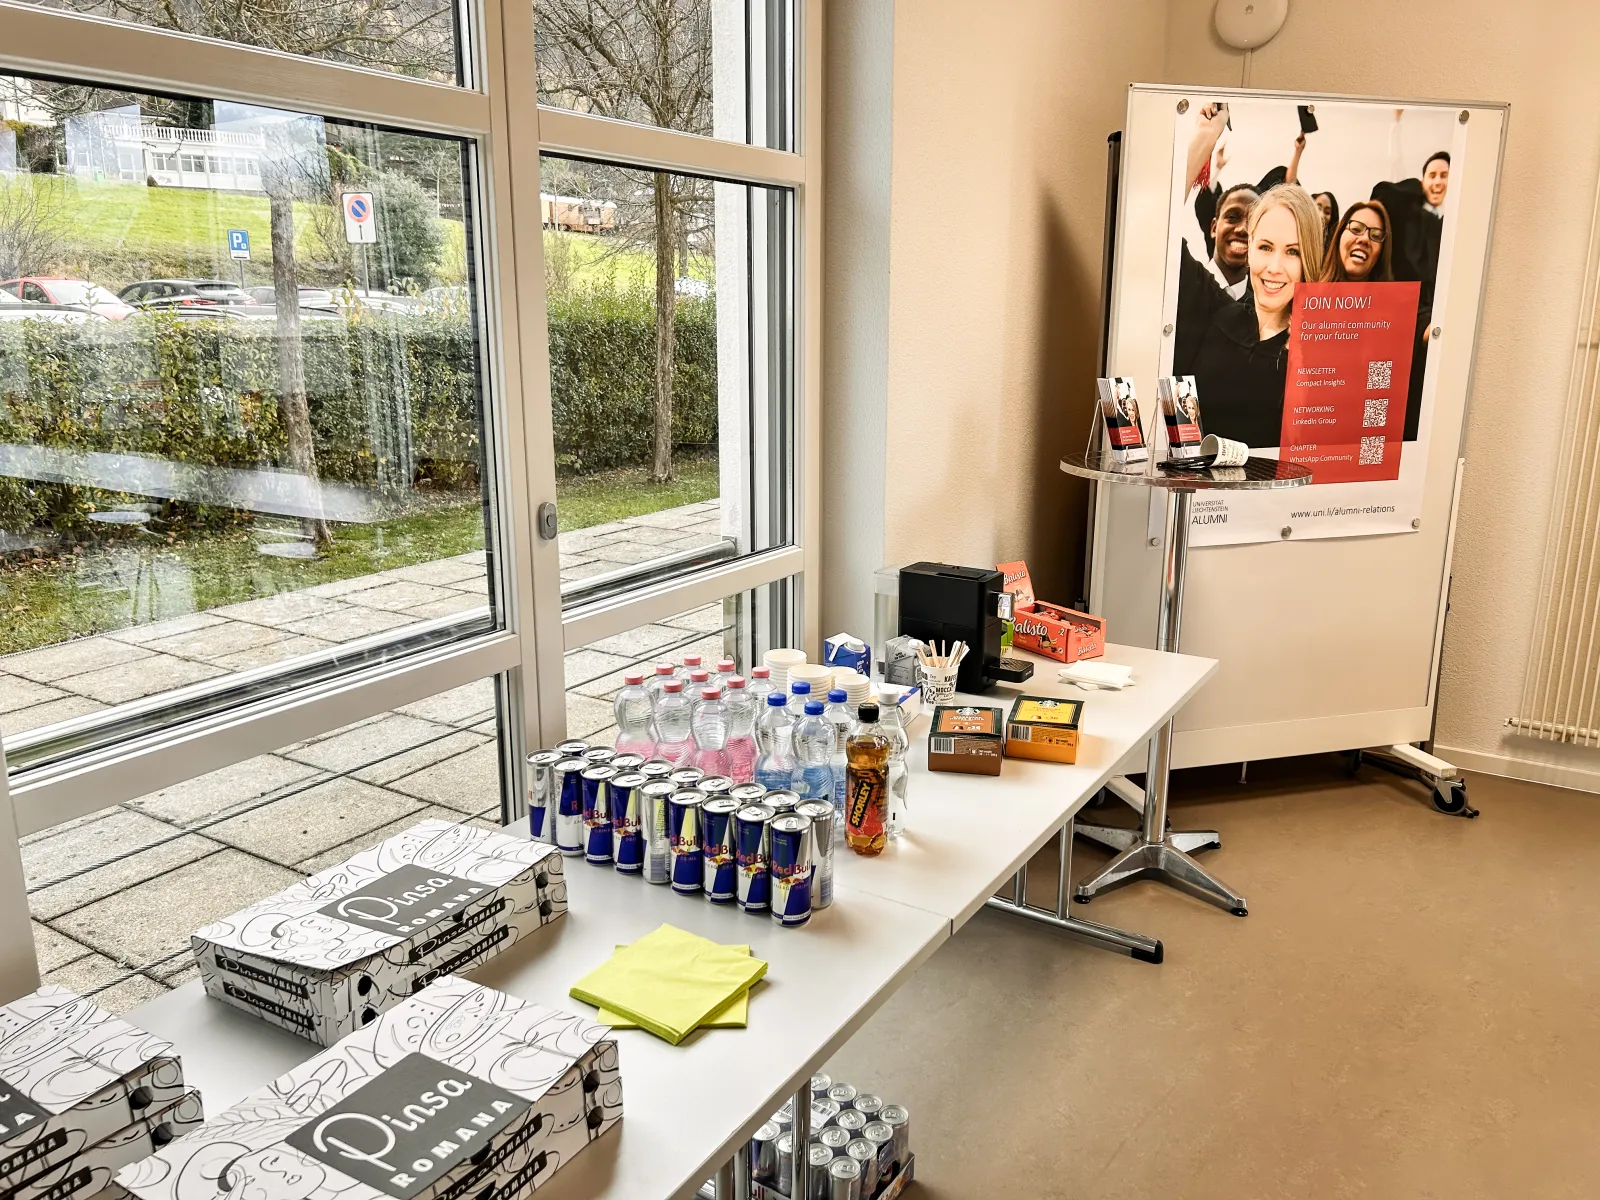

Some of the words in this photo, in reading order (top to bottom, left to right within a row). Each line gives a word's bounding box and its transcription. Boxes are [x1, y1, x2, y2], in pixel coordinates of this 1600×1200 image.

[1303, 297, 1331, 309] JOIN
[1335, 296, 1371, 309] NOW!
[1300, 332, 1312, 340] for
[1334, 331, 1359, 339] future
[1301, 321, 1316, 329] Our
[1319, 321, 1345, 329] alumni
[1348, 320, 1391, 329] community
[1324, 379, 1345, 387] Insights
[1320, 454, 1353, 462] Community
[1192, 514, 1227, 524] ALUMNI
[1291, 504, 1395, 519] www.uni.li/alumni-relations
[1004, 570, 1026, 584] Balisto
[852, 783, 870, 825] SHORLEY
[772, 860, 792, 875] Red
[794, 859, 810, 874] Bull
[337, 878, 453, 926] Pinsa
[396, 887, 484, 933] ROMANA
[416, 926, 467, 957] Pinsa
[467, 901, 502, 928] ROMANA
[221, 957, 267, 982] Pinsa
[268, 975, 303, 995] ROMANA
[419, 956, 471, 987] Pinsa
[471, 931, 504, 957] ROMANA
[229, 985, 274, 1012] Pinsa
[274, 1005, 309, 1026] ROMANA
[313, 1079, 473, 1172] Pinsa
[0, 1137, 57, 1173] OMANA
[389, 1100, 513, 1189] ROMANA
[491, 1123, 536, 1166] ROMANA
